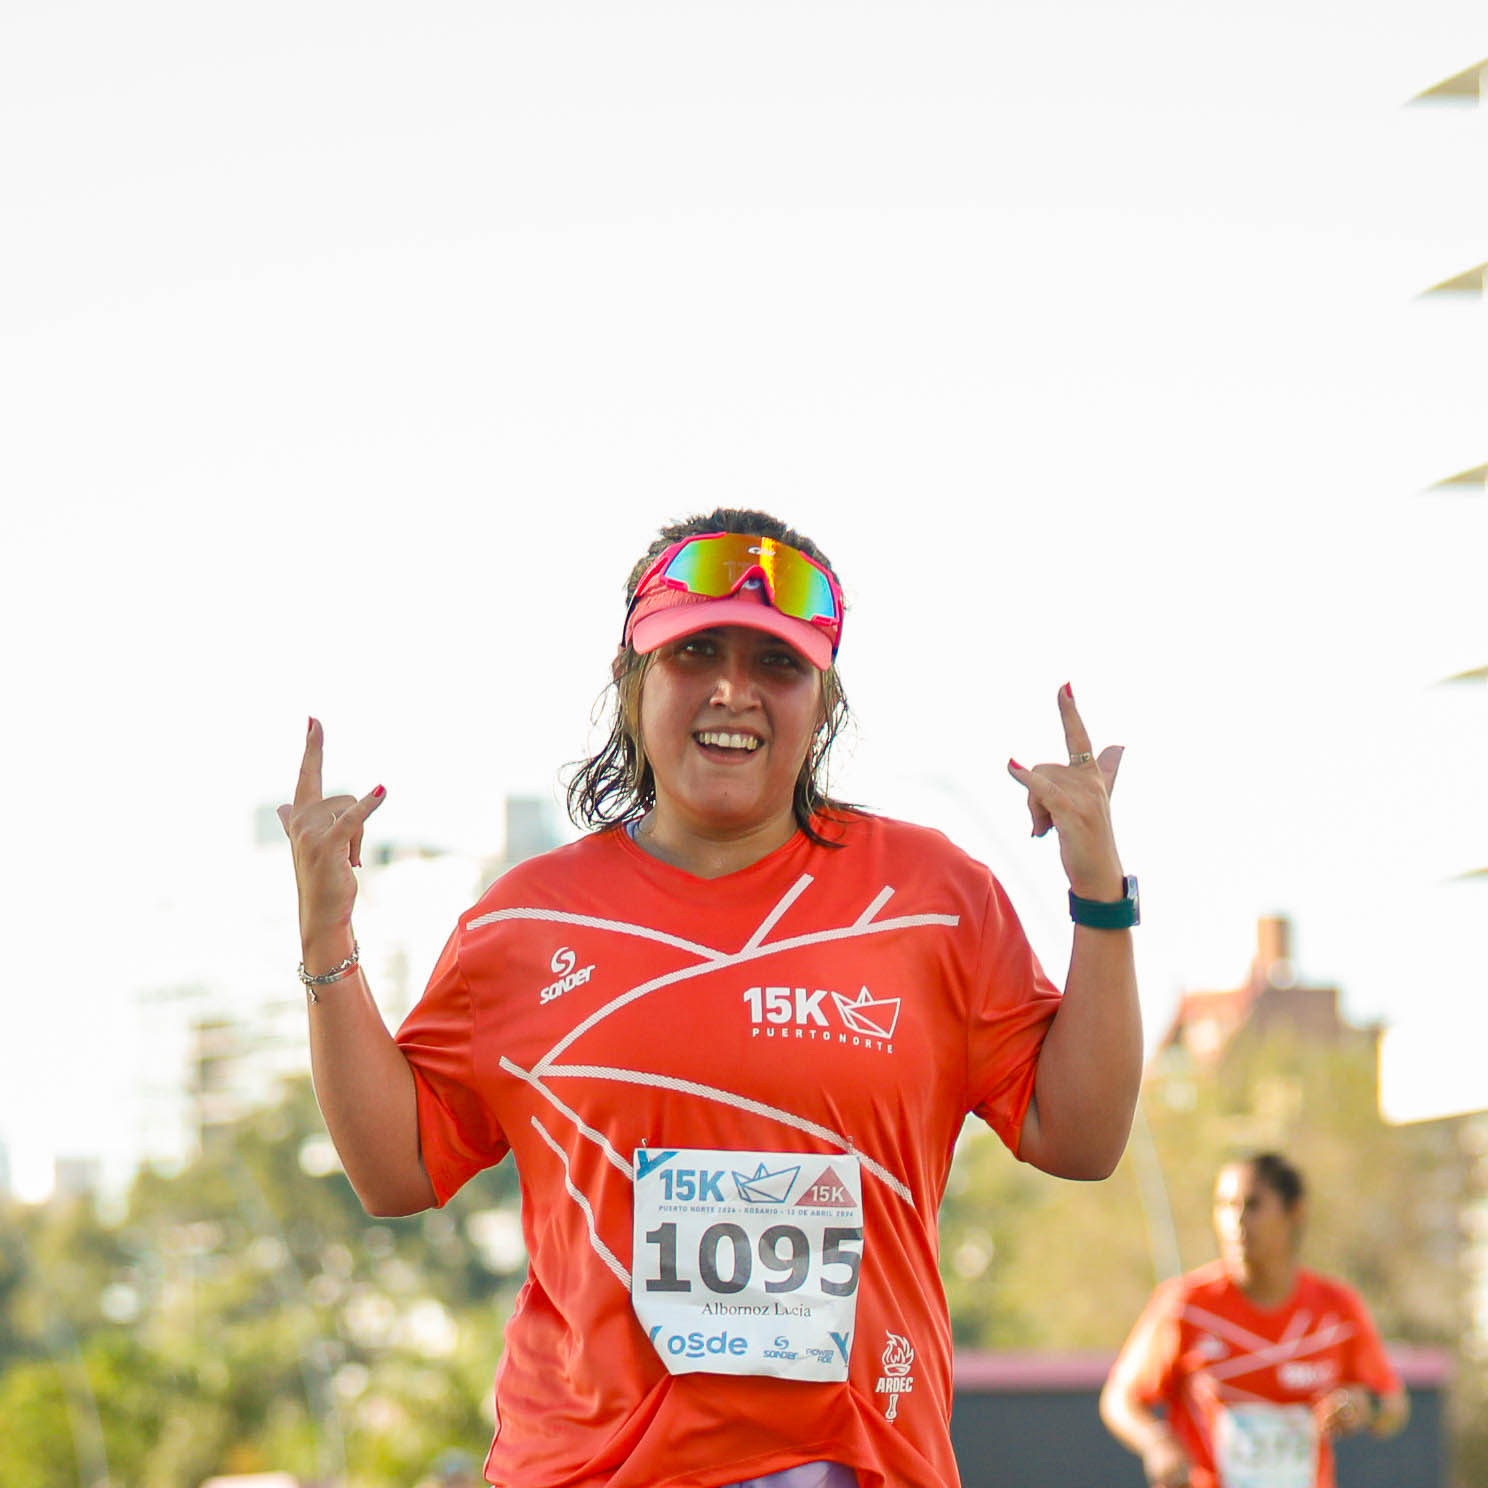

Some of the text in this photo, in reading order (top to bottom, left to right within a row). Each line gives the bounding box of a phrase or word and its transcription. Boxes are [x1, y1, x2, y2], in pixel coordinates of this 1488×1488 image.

[743, 987, 829, 1026] 15K
[752, 1027, 893, 1054] PUERTO NORTE
[659, 1169, 725, 1202] 15K
[811, 1185, 845, 1203] 15K
[659, 1205, 688, 1213] PUERTO
[690, 1205, 715, 1214] NORTE
[744, 1207, 778, 1215] ROSARIO
[798, 1208, 809, 1217] DE
[811, 1209, 833, 1217] ABRIL
[645, 1222, 863, 1297] 1095
[702, 1302, 770, 1317] Albornoz
[667, 1331, 748, 1358] osde
[875, 1376, 914, 1393] ARDEC
